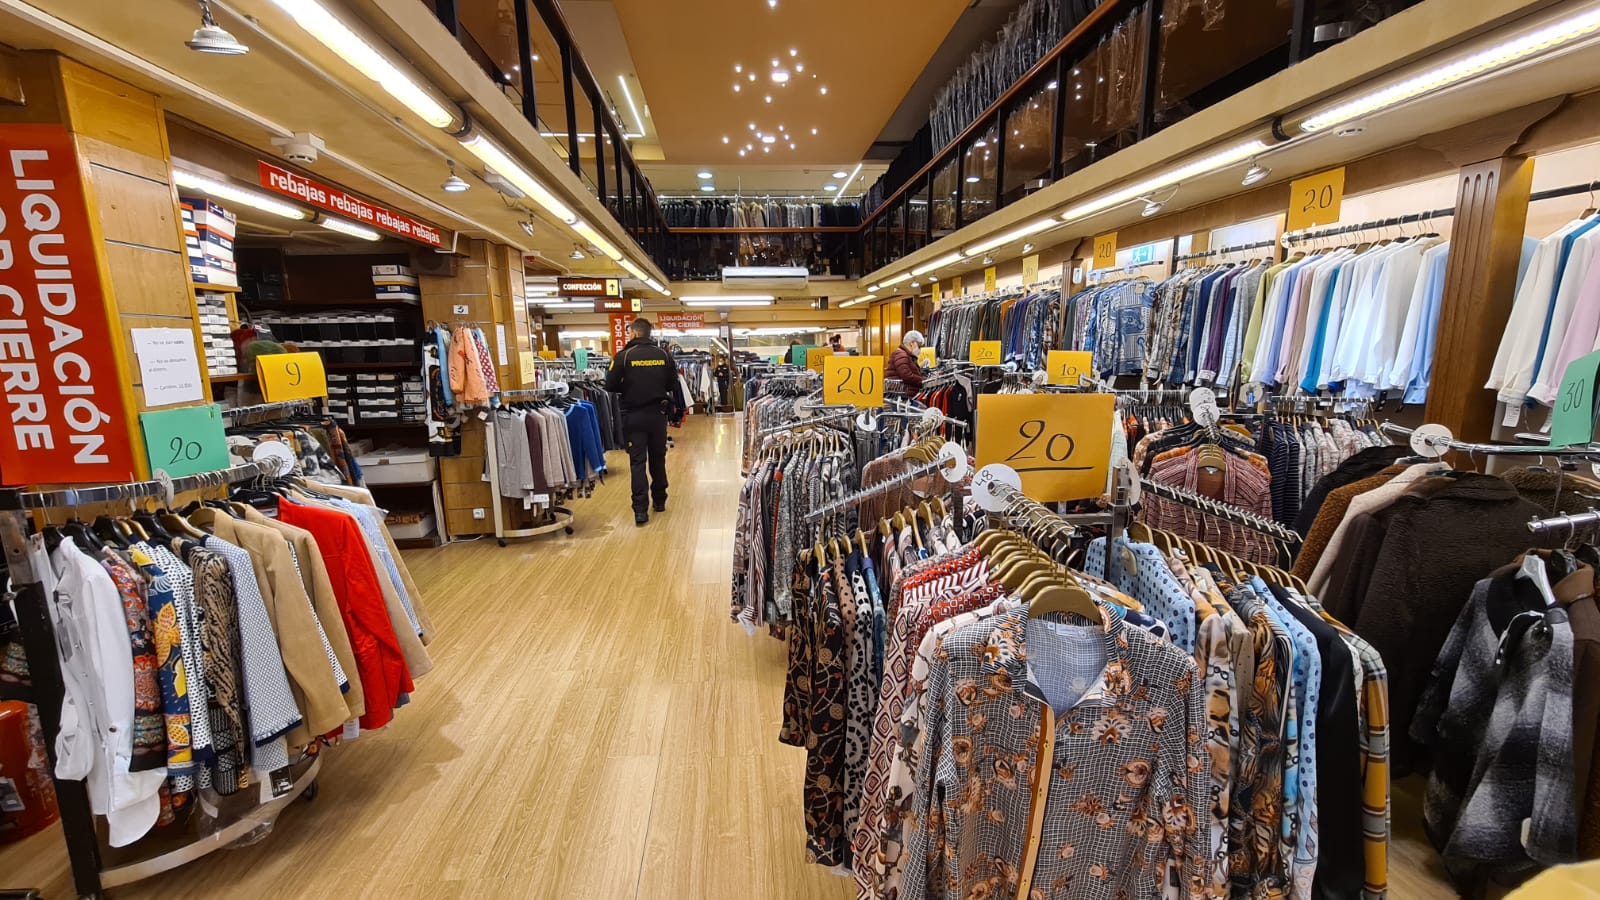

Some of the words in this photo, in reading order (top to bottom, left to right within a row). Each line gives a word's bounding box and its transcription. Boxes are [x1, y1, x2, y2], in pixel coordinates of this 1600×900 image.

[270, 172, 327, 203] rebajas
[330, 193, 374, 220] rebajas
[376, 210, 411, 233] rebajas
[412, 223, 441, 244] rebajas
[1303, 184, 1333, 213] 20
[1099, 241, 1112, 259] 20
[562, 282, 603, 291] CONFECCIÓN
[10, 149, 111, 464] LIQUIDACIÓN
[285, 362, 302, 386] 9
[631, 359, 666, 368] PROSEGUR
[1061, 363, 1077, 377] 10
[837, 366, 874, 395] 20
[1562, 378, 1585, 413] 30
[169, 436, 202, 465] 20
[1005, 420, 1075, 462] 20
[975, 469, 994, 487] 48
